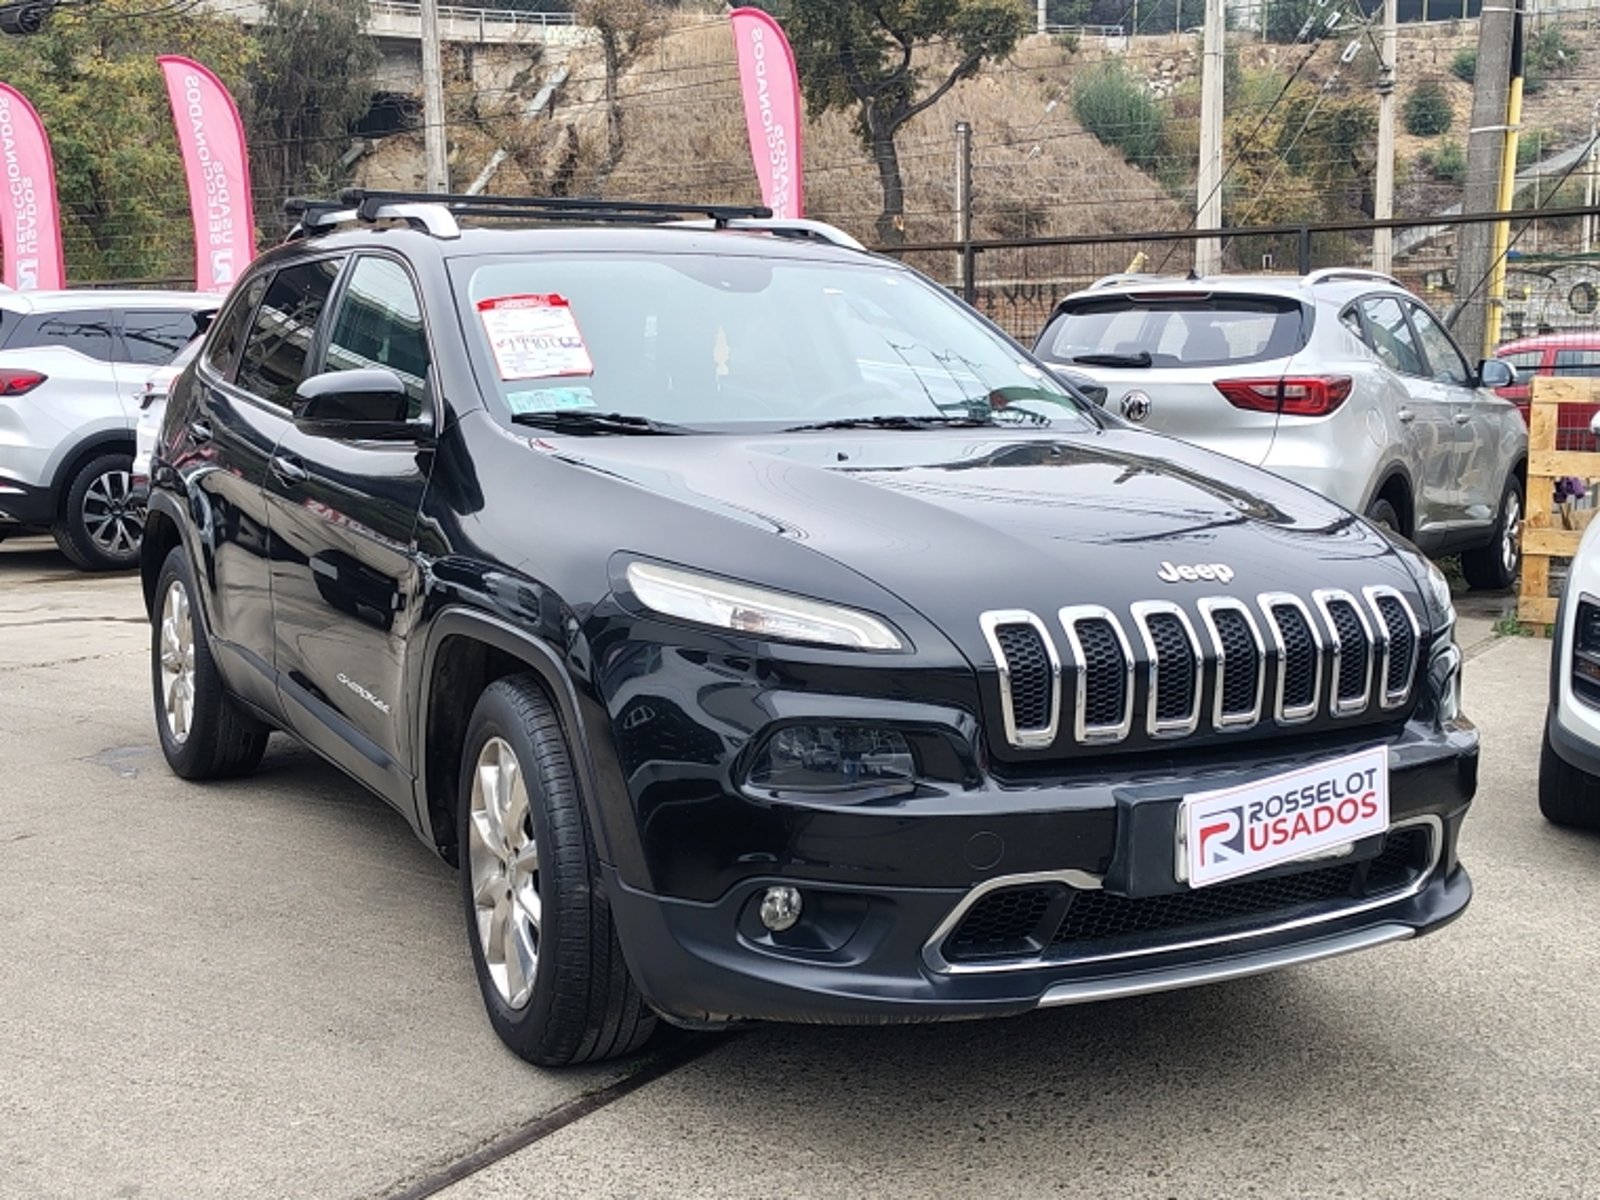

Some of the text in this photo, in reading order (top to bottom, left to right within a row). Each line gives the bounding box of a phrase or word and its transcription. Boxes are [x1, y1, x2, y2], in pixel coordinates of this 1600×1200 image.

[1157, 561, 1234, 585] Jeep
[1249, 768, 1377, 824] ROSSELOT
[1249, 792, 1377, 852] USADOS
